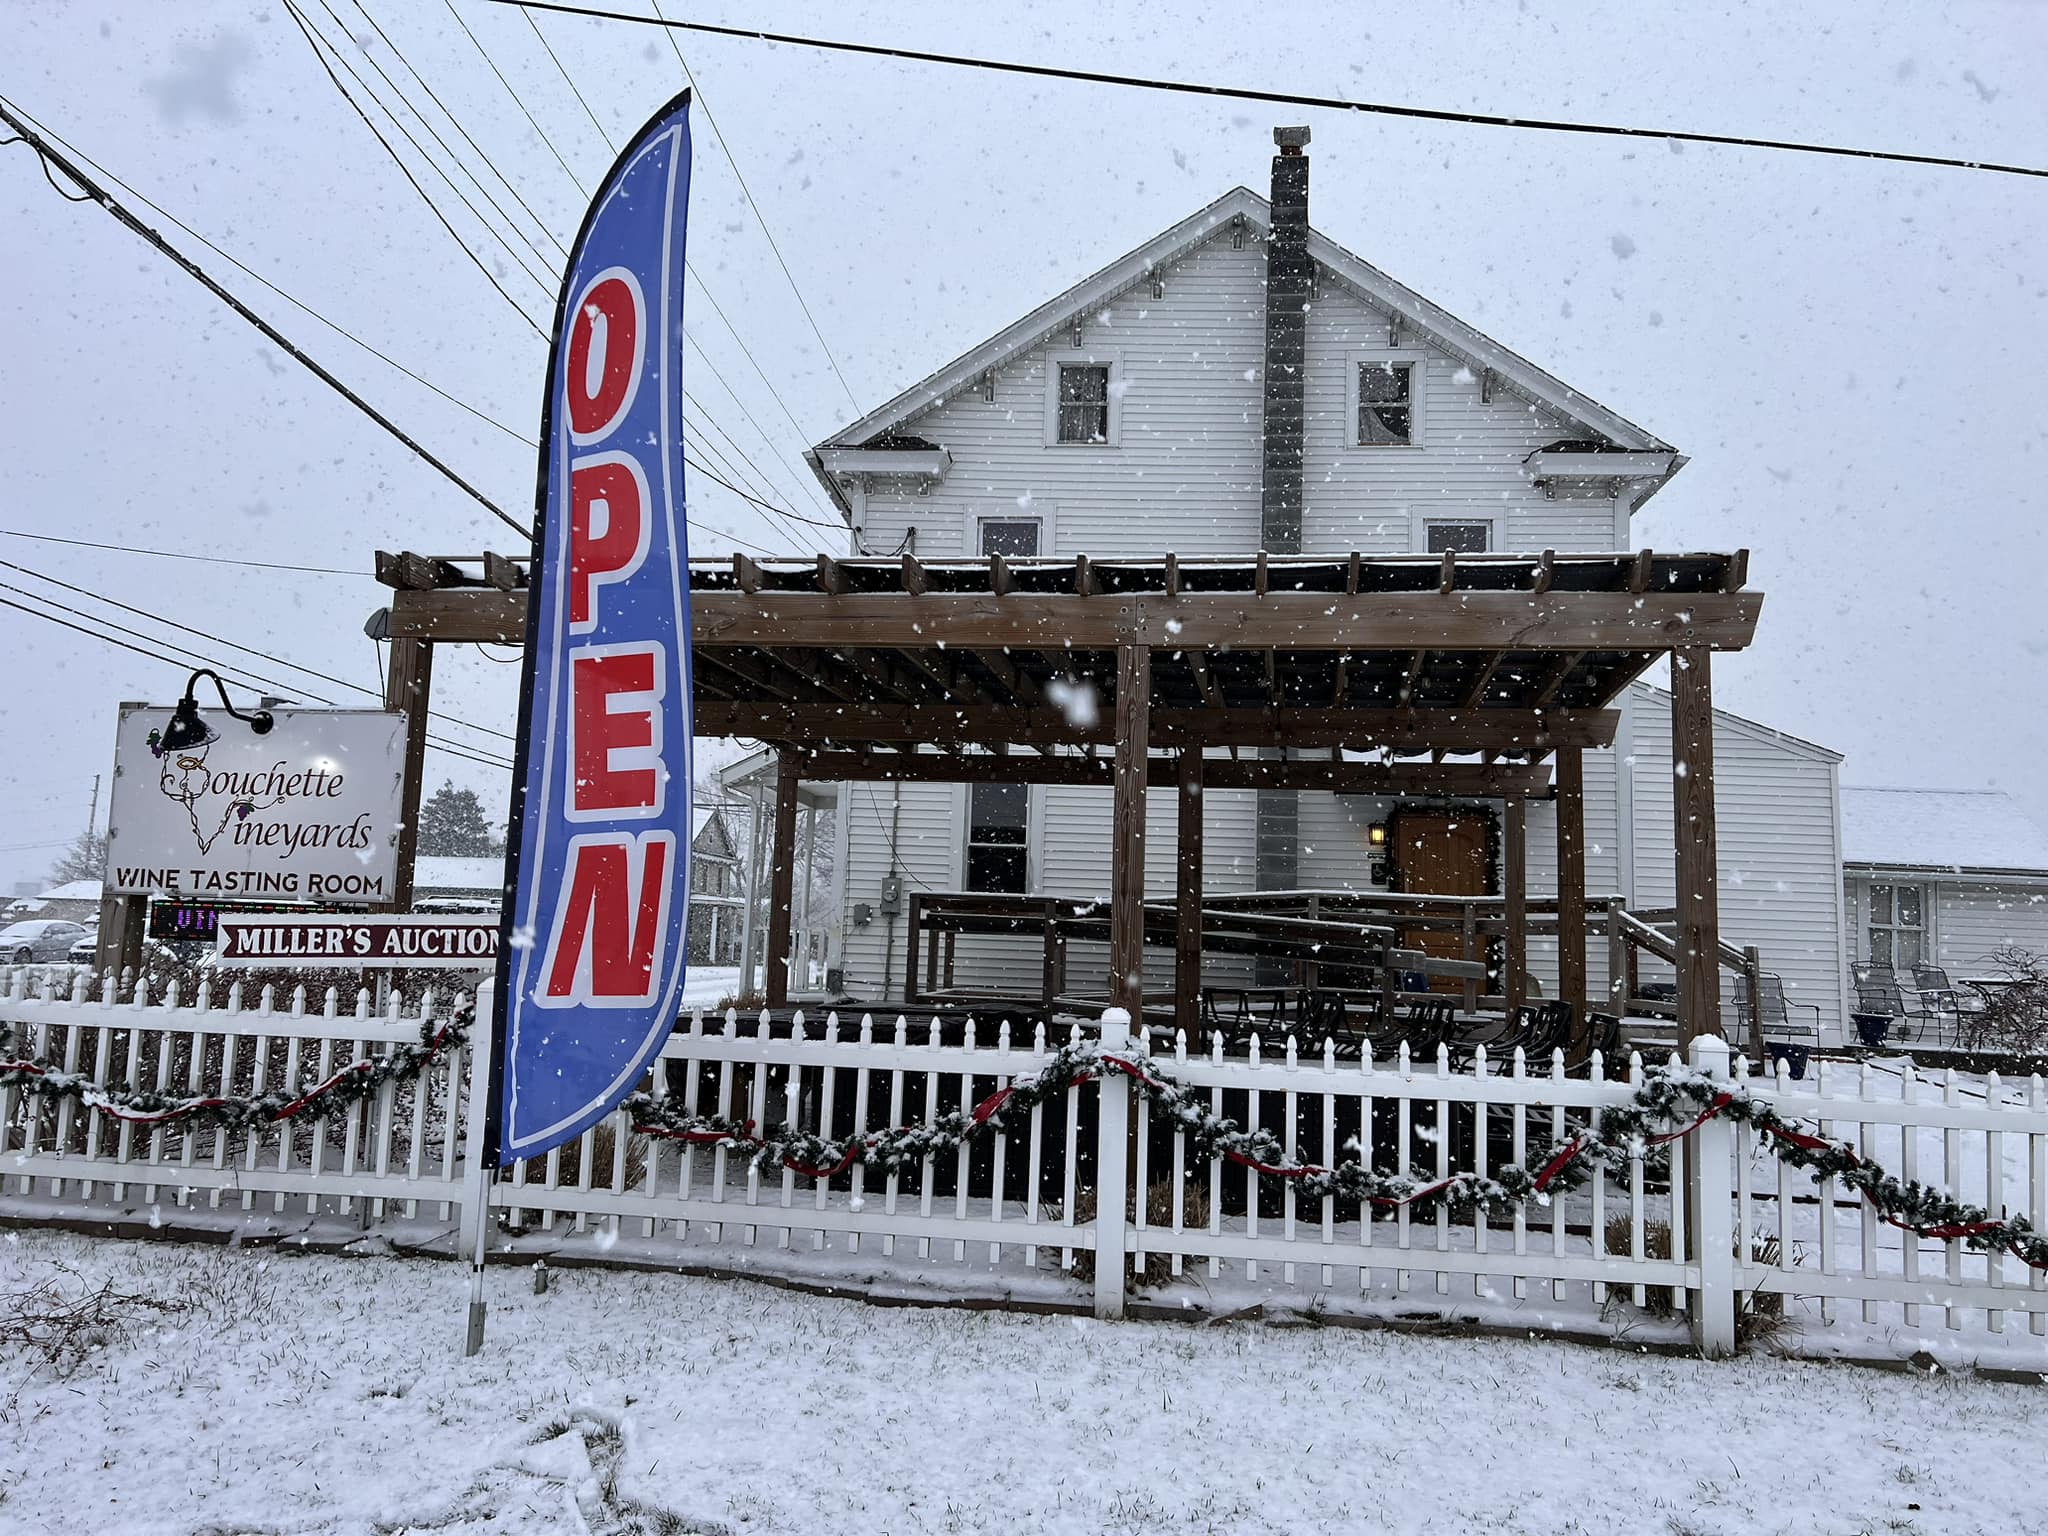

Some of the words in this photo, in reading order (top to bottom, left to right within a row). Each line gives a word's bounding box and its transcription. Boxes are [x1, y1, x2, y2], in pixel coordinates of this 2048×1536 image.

[545, 272, 668, 1003] OPEN
[183, 797, 372, 858] Vineyards
[117, 868, 181, 889] WINE
[190, 870, 298, 893] TASTING
[308, 874, 383, 895] ROOM
[236, 928, 372, 954] MILLER'S
